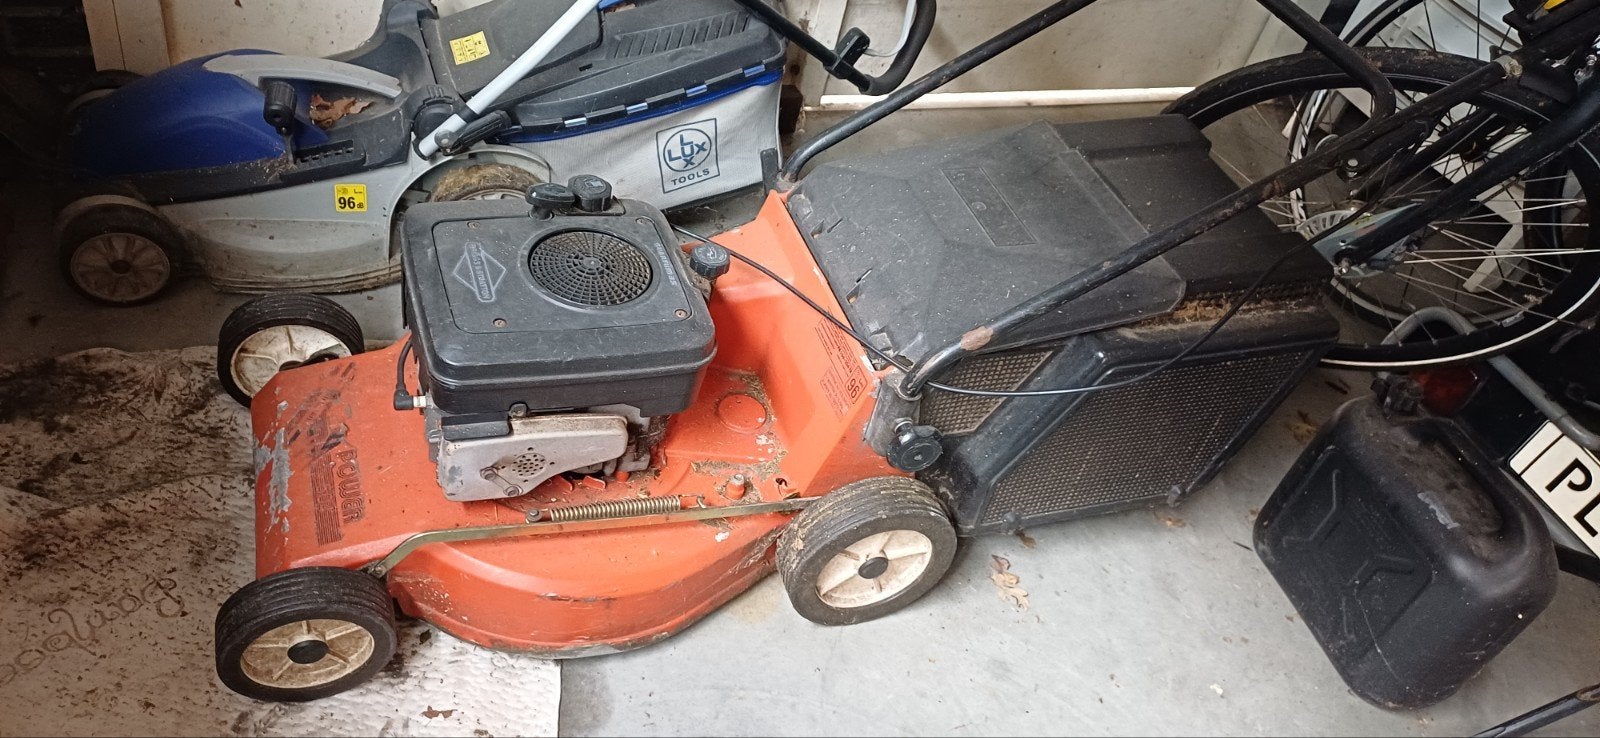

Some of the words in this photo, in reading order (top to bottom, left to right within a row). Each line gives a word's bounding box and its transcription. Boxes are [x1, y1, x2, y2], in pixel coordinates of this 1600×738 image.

[671, 168, 710, 186] TOOLS
[338, 196, 356, 210] 96
[847, 378, 860, 399] 96
[337, 449, 365, 524] POWER
